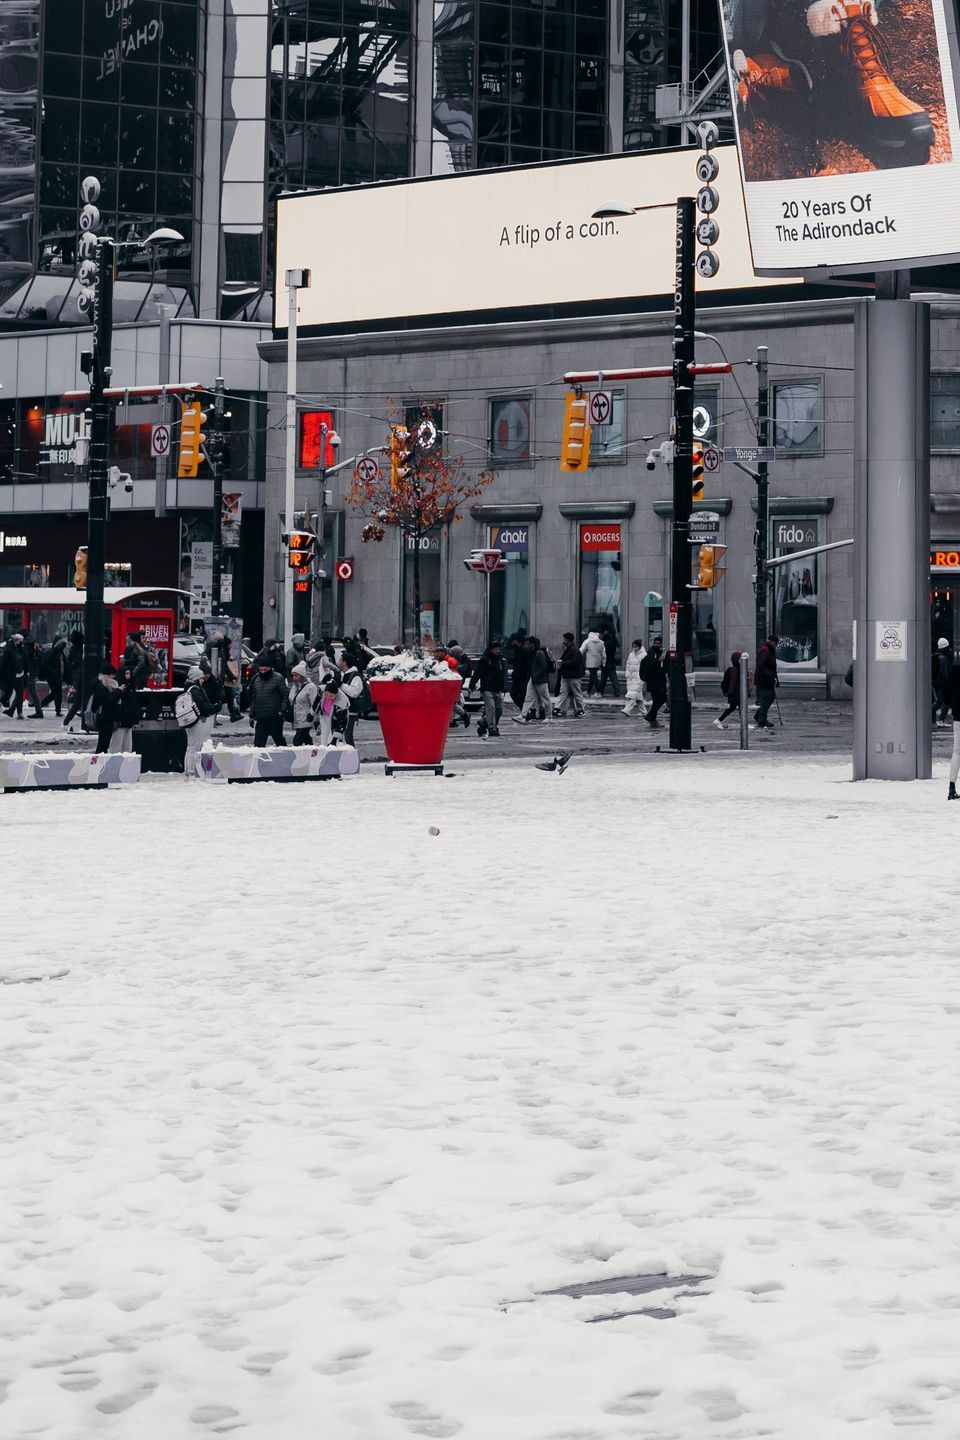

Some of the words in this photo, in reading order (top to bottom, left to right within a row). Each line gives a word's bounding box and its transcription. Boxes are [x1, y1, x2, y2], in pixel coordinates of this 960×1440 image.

[782, 201, 799, 219] 20
[801, 200, 846, 217] Years
[850, 194, 872, 213] Of
[500, 227, 510, 246] A
[515, 225, 540, 248] flip
[545, 221, 562, 241] of
[565, 225, 574, 239] a
[579, 220, 619, 238] coin.
[776, 225, 798, 242] The
[802, 216, 897, 240] Adirondack
[675, 208, 683, 316] DOWNTOWN
[45, 412, 90, 446] MUJ
[736, 449, 757, 461] Yonge
[690, 522, 708, 531] Dundas
[777, 525, 804, 543] fido
[500, 529, 527, 544] chatr
[592, 532, 620, 542] ROGERS
[295, 582, 308, 591] 302
